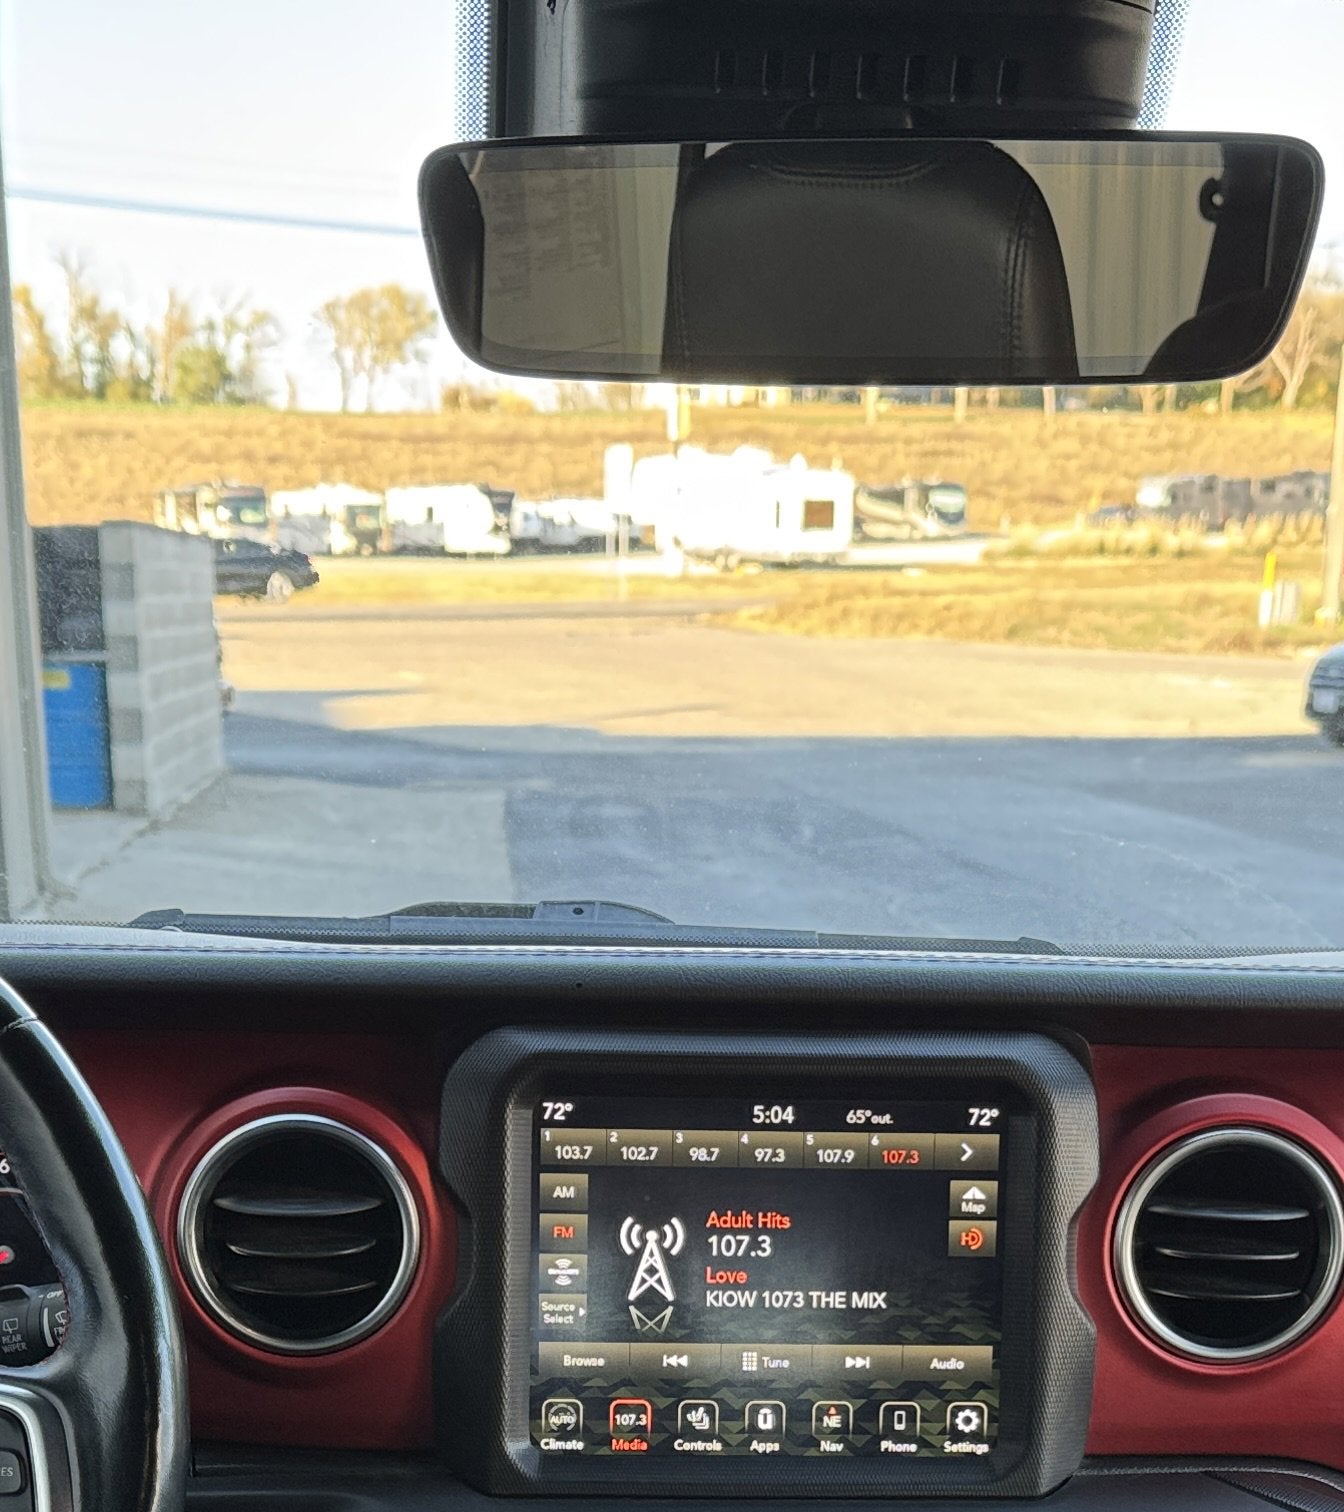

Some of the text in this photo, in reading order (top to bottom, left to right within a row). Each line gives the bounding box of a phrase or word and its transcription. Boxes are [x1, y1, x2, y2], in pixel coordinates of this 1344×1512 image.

[543, 1103, 573, 1120] 72°
[752, 1106, 795, 1124] 5:04
[969, 1108, 999, 1126] 72°
[545, 1132, 550, 1141] 1
[610, 1132, 618, 1142] 2
[675, 1132, 683, 1143] 3
[740, 1133, 749, 1144] 4
[806, 1134, 814, 1145] 5
[871, 1134, 879, 1145] 6
[555, 1146, 593, 1160] 103.7
[621, 1146, 658, 1161] 102.7
[689, 1147, 719, 1161] 98.7
[755, 1148, 785, 1162] 97.3
[817, 1149, 854, 1163] 107.9
[882, 1150, 920, 1164] 107.3
[0, 1158, 11, 1174] 6
[553, 1186, 575, 1198] AM
[961, 1201, 986, 1214] Map
[706, 1210, 791, 1229] Adult Hits
[553, 1226, 574, 1238] FM
[708, 1235, 771, 1257] 107.3
[706, 1266, 747, 1284] Love
[706, 1290, 887, 1309] KIOW 1073 THE MIX
[541, 1302, 575, 1312] Source
[543, 1314, 574, 1324] Select
[563, 1355, 605, 1367] Browse
[762, 1357, 790, 1369] Tune
[930, 1358, 964, 1370] Audio
[549, 1413, 575, 1424] AUTO
[614, 1414, 647, 1426] 107.3
[823, 1416, 841, 1428] NE
[541, 1439, 584, 1451] Climate
[612, 1439, 647, 1451] Media
[674, 1439, 722, 1451] Controls
[750, 1440, 780, 1453] Apps
[820, 1440, 843, 1452] Nav
[880, 1440, 919, 1453] Phone
[944, 1440, 988, 1455] Settings
